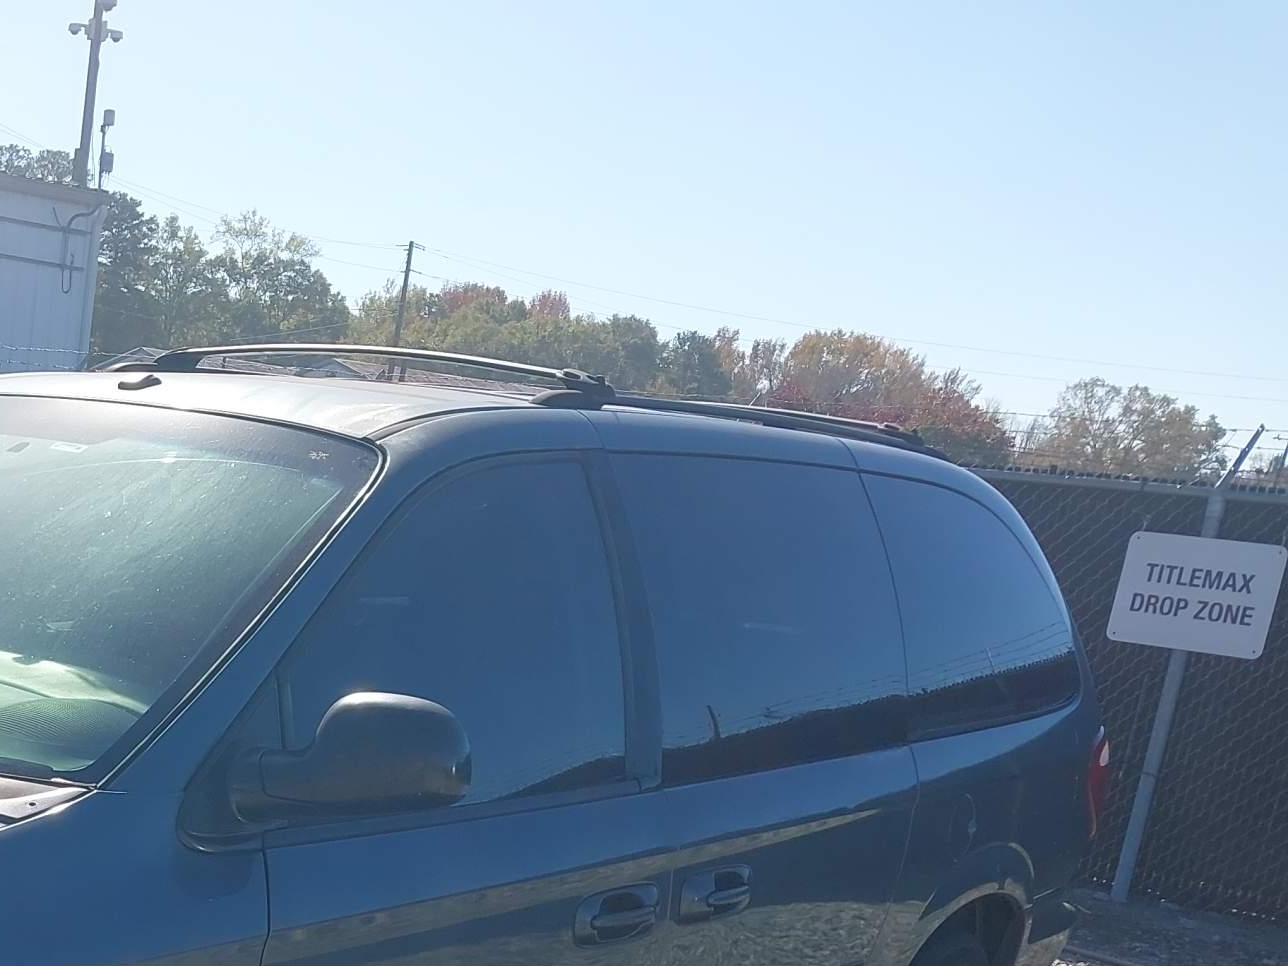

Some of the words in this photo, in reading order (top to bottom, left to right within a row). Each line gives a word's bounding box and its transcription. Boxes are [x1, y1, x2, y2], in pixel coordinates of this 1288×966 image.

[1147, 563, 1256, 594] TITLEMAX
[1129, 592, 1189, 617] DROP
[1193, 600, 1255, 626] ZONE
